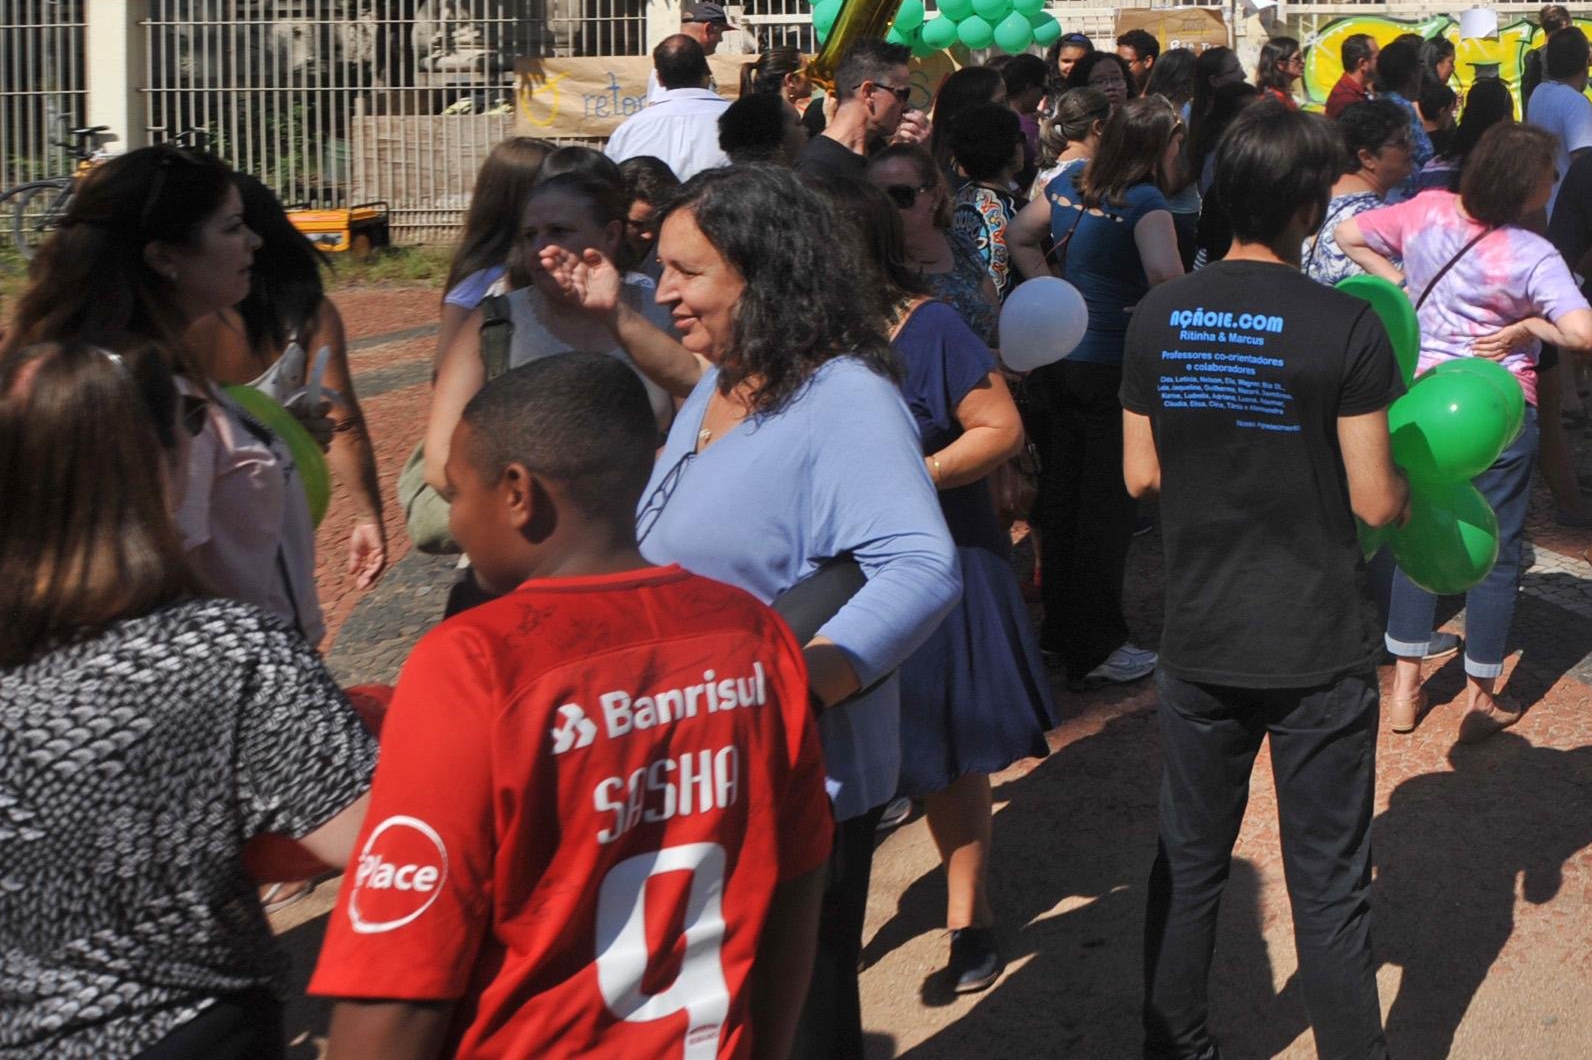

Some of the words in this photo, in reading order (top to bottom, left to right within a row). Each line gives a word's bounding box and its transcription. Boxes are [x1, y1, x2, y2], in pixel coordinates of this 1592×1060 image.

[1162, 350, 1212, 360] Professores
[1214, 352, 1284, 367] co-orientadores
[1180, 330, 1216, 342] Ritinha
[1218, 332, 1227, 342] &
[1228, 333, 1264, 346] Marcus
[1194, 363, 1256, 375] colaboradores
[599, 660, 766, 741] Banrisul
[593, 746, 739, 845] SASHA
[595, 841, 732, 1060] 9
